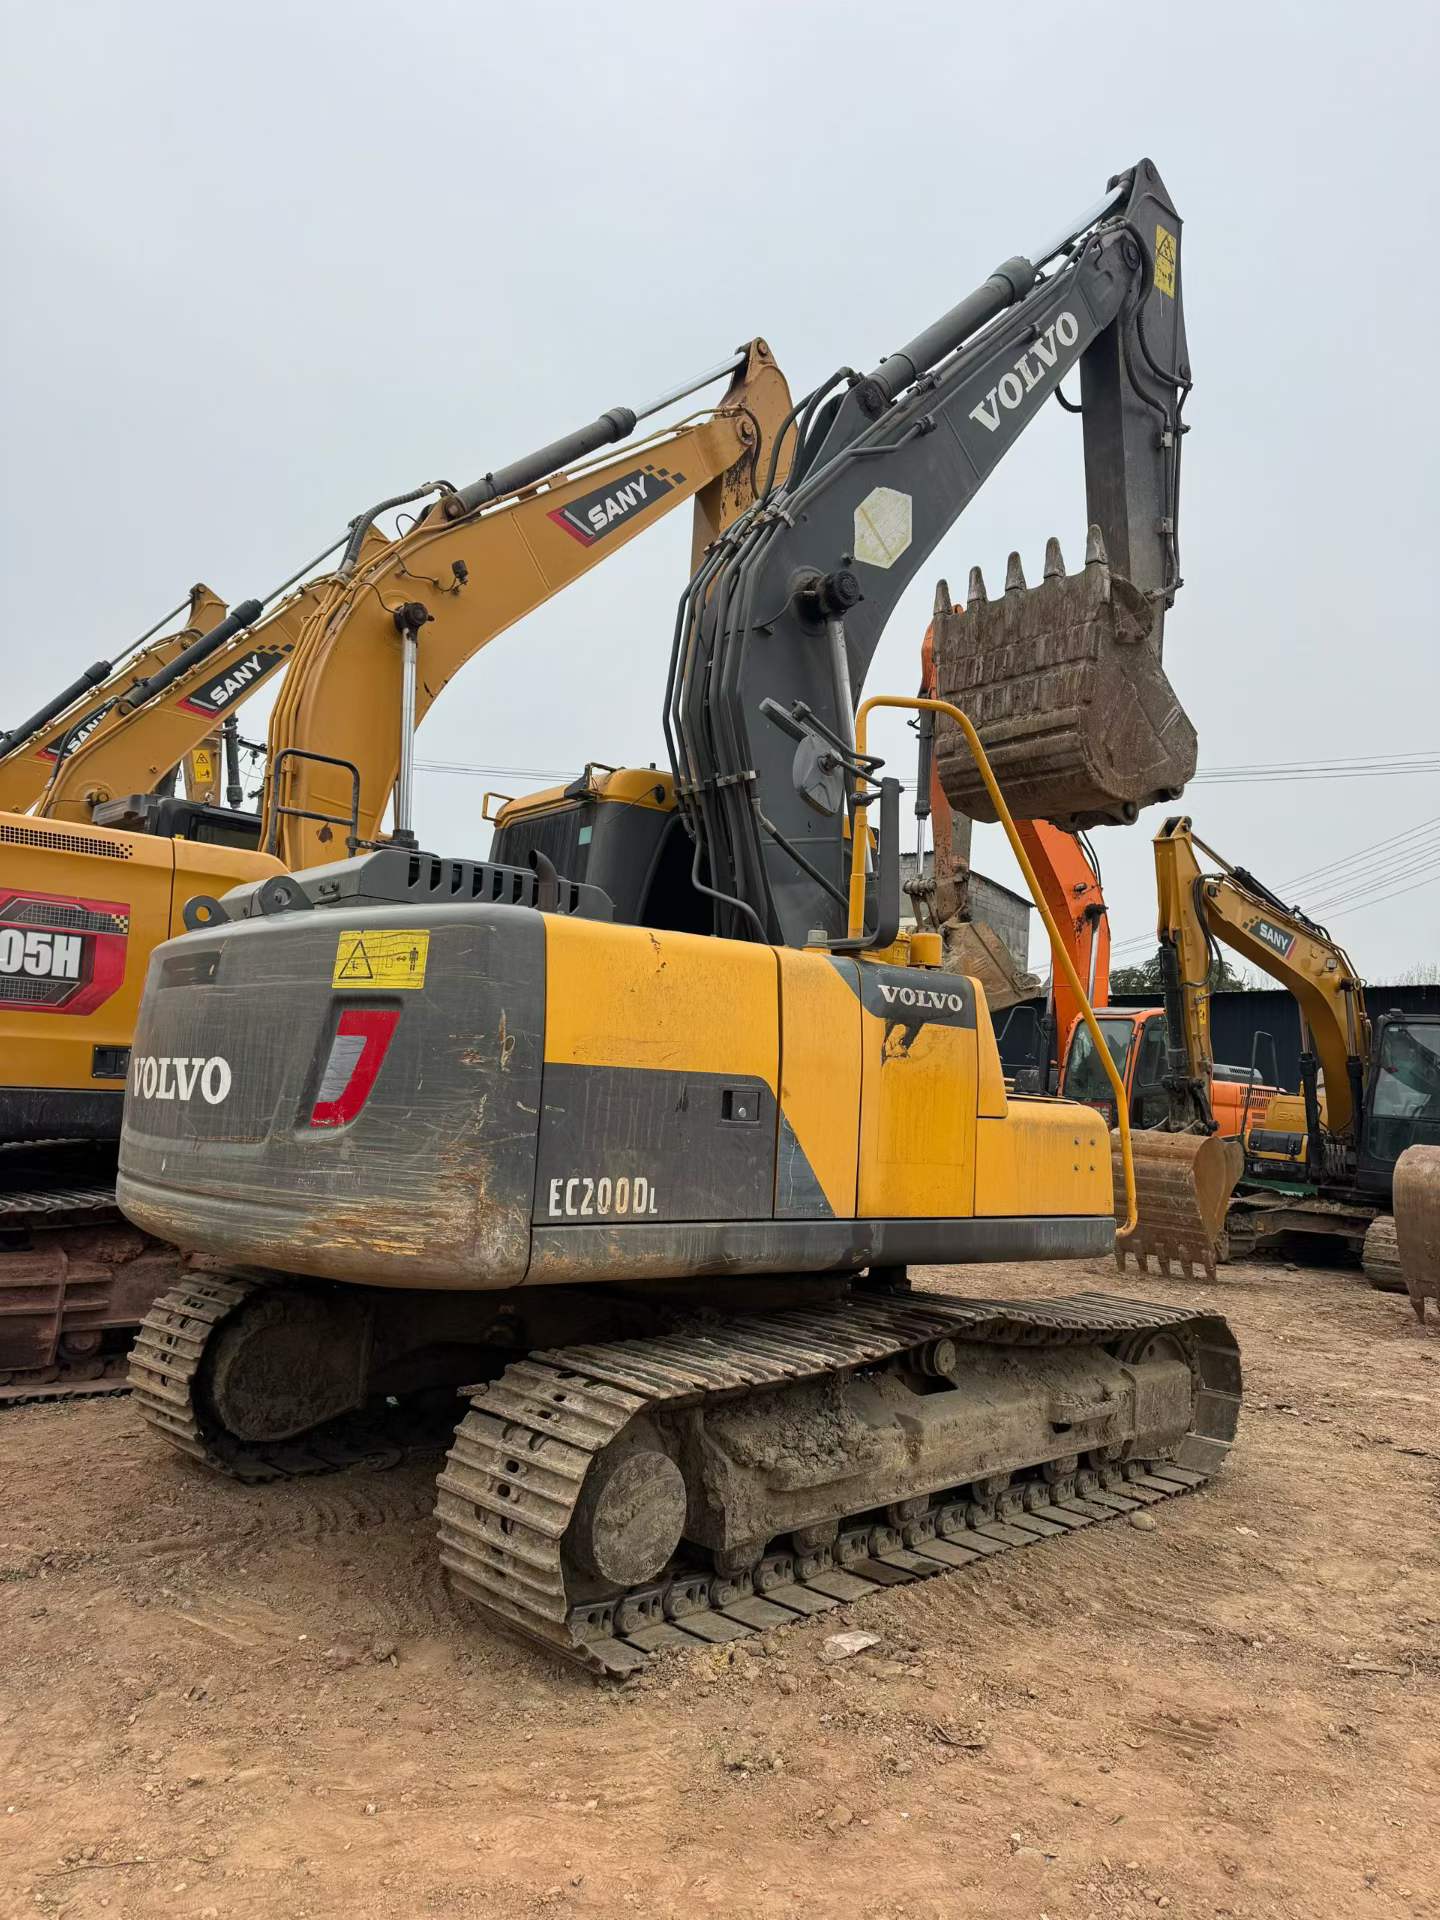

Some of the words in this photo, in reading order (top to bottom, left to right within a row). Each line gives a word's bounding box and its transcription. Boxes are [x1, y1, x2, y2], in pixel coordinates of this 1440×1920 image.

[968, 312, 1079, 432] VOLVO
[588, 475, 648, 531] SANY
[210, 654, 262, 706] SANY
[0, 928, 82, 979] 05H
[1259, 923, 1289, 950] SANY
[877, 984, 963, 1012] VOLVO
[133, 1055, 232, 1105] VOLVO
